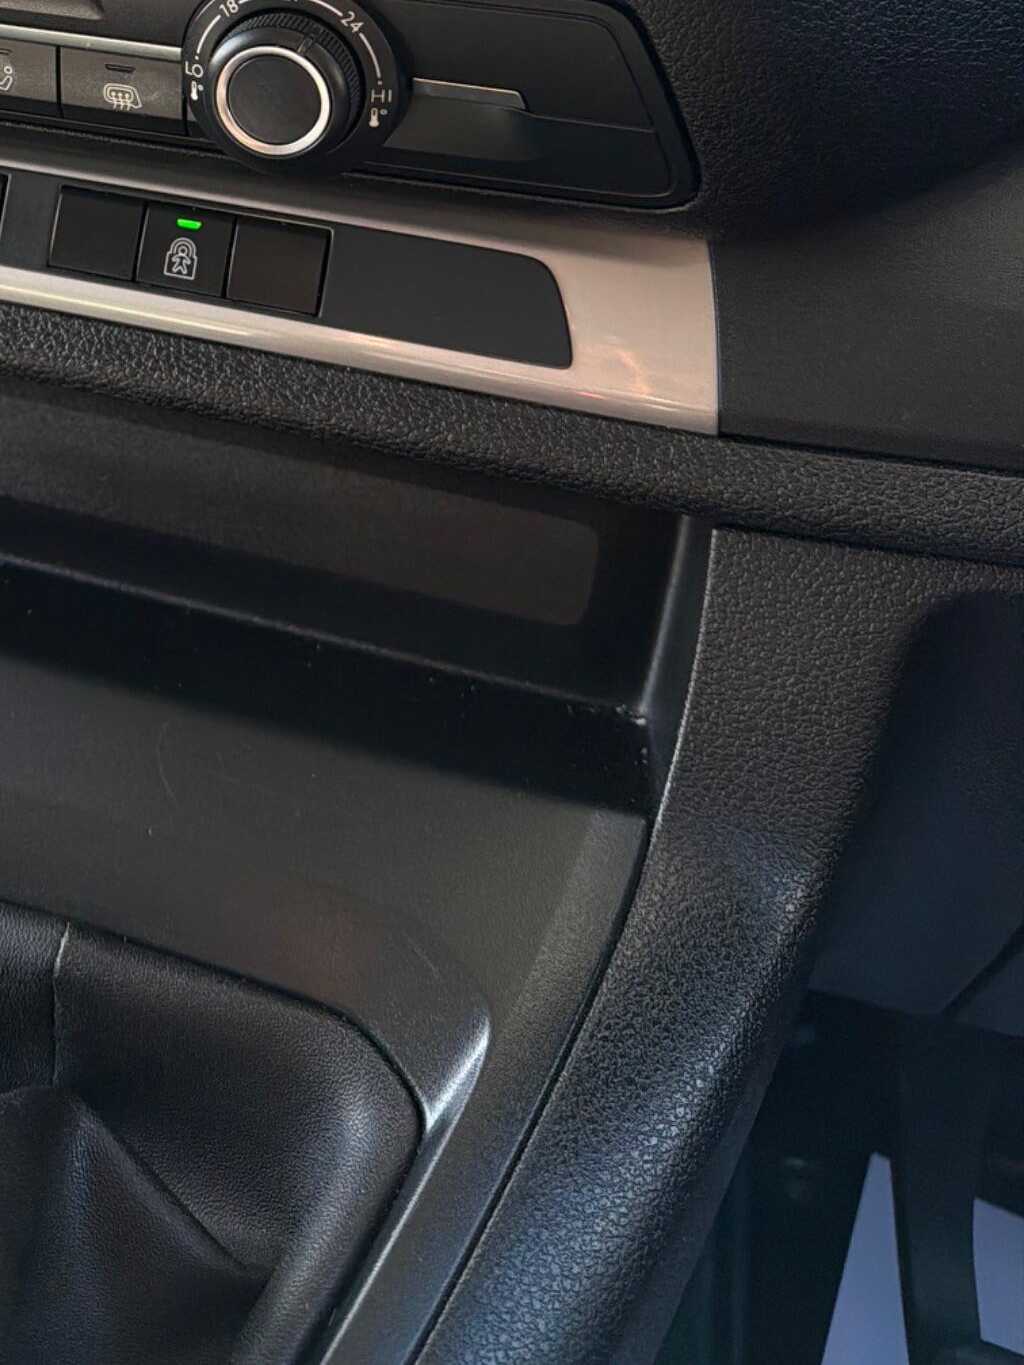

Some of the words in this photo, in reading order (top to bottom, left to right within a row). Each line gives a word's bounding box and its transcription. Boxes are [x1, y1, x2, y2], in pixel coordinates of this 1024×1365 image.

[219, 0, 239, 17] 18
[341, 12, 363, 33] 24
[185, 61, 204, 78] LO
[371, 89, 392, 103] HI
